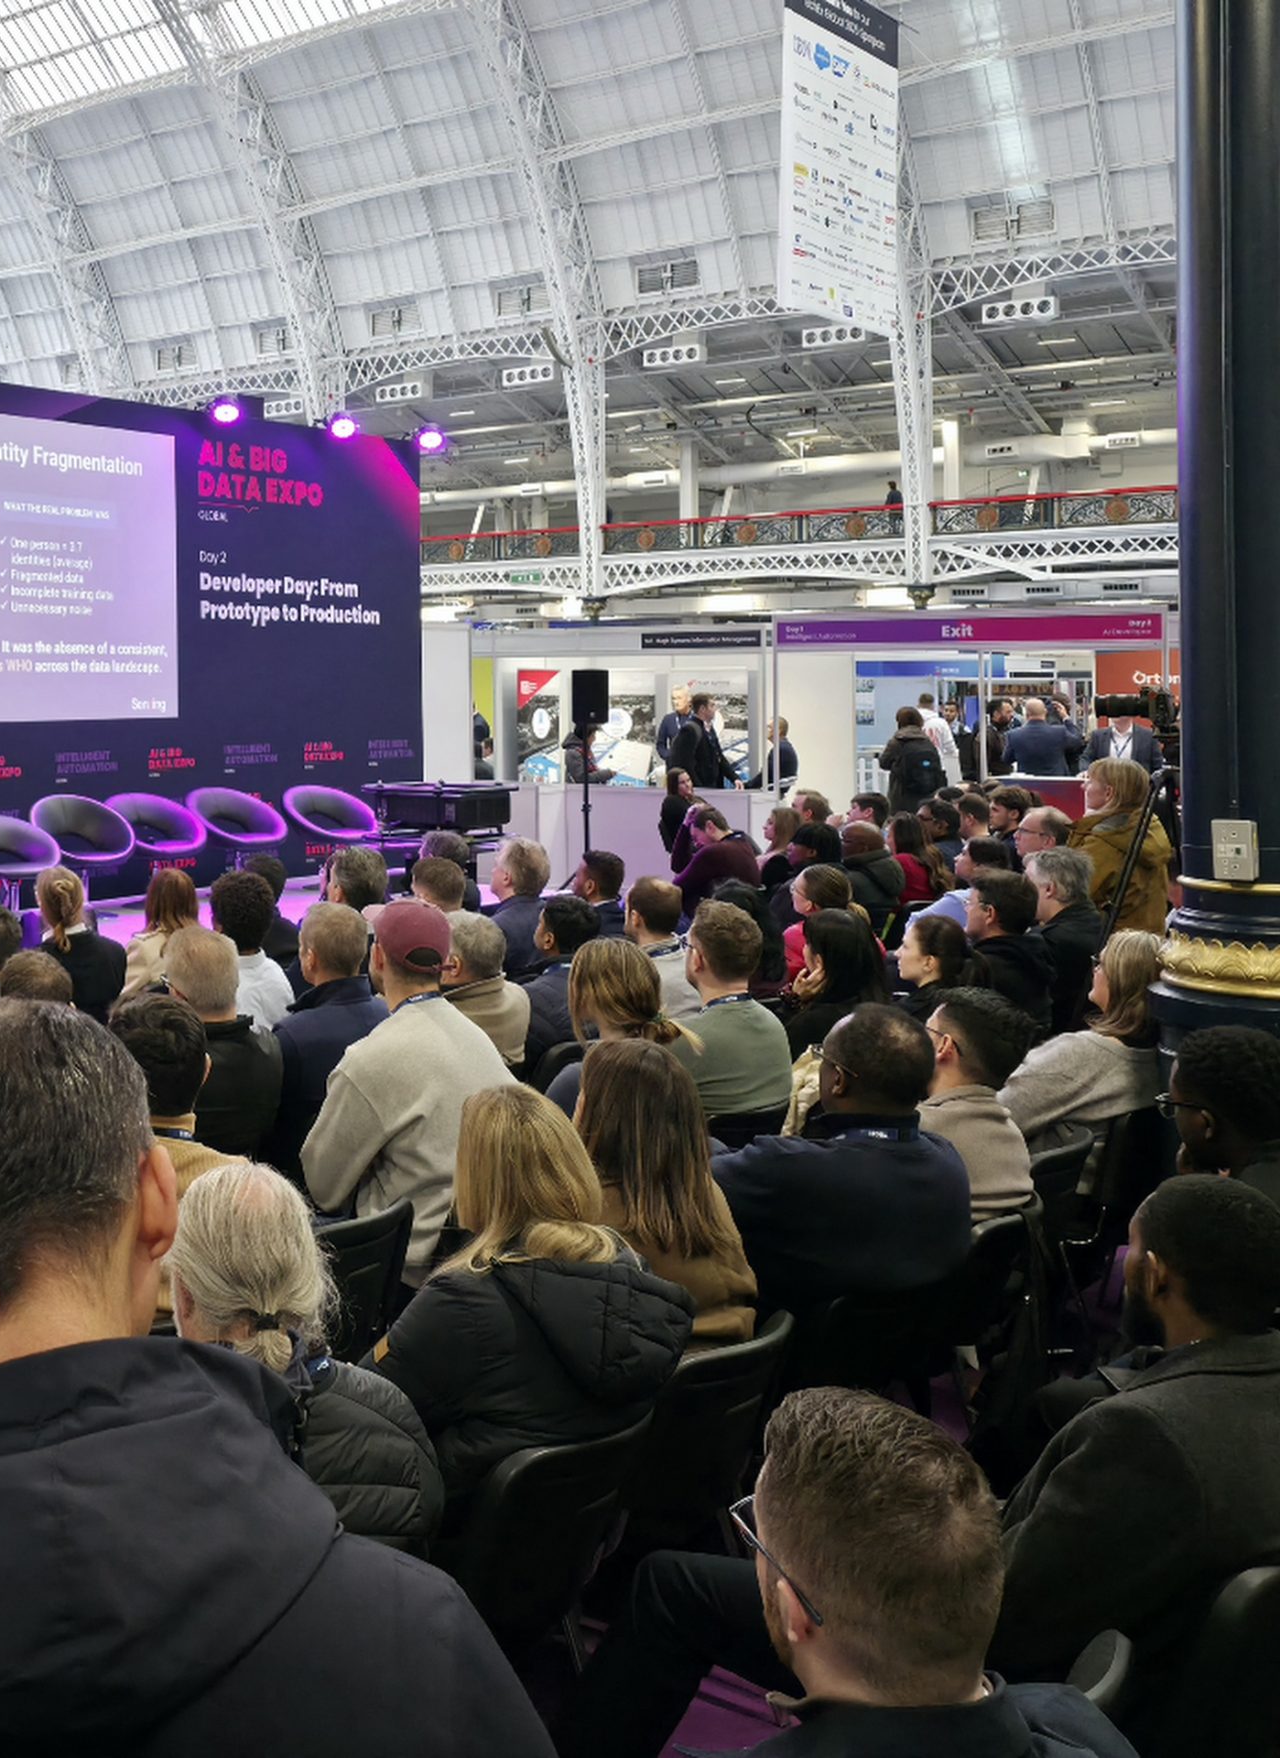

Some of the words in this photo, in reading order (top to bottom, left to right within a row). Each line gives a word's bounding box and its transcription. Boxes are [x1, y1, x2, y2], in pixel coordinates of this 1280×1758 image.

[34, 446, 143, 477] Fragmentation
[199, 439, 223, 467] AI
[227, 442, 245, 470] &
[250, 445, 288, 473] BIG
[198, 471, 261, 502] DATA
[266, 479, 324, 507] EXPO
[199, 551, 218, 566] Day
[220, 552, 227, 564] 2
[199, 572, 282, 599] Developer
[284, 577, 318, 600] Day:
[320, 579, 358, 598] From
[200, 601, 280, 626] Prototype
[282, 604, 297, 622] to
[300, 605, 380, 625] Production
[941, 623, 974, 638] Exit
[2, 640, 10, 653] It
[12, 642, 32, 653] was
[35, 640, 52, 654] the
[54, 641, 94, 655] absence
[97, 641, 108, 654] of
[110, 644, 116, 654] a
[6, 659, 33, 672] WHO
[35, 662, 70, 673] across
[71, 659, 88, 673] the
[89, 660, 110, 674] data
[112, 660, 162, 676] landscape.
[56, 750, 110, 763] INTELLIGENT
[56, 762, 118, 774] AUTOMATION
